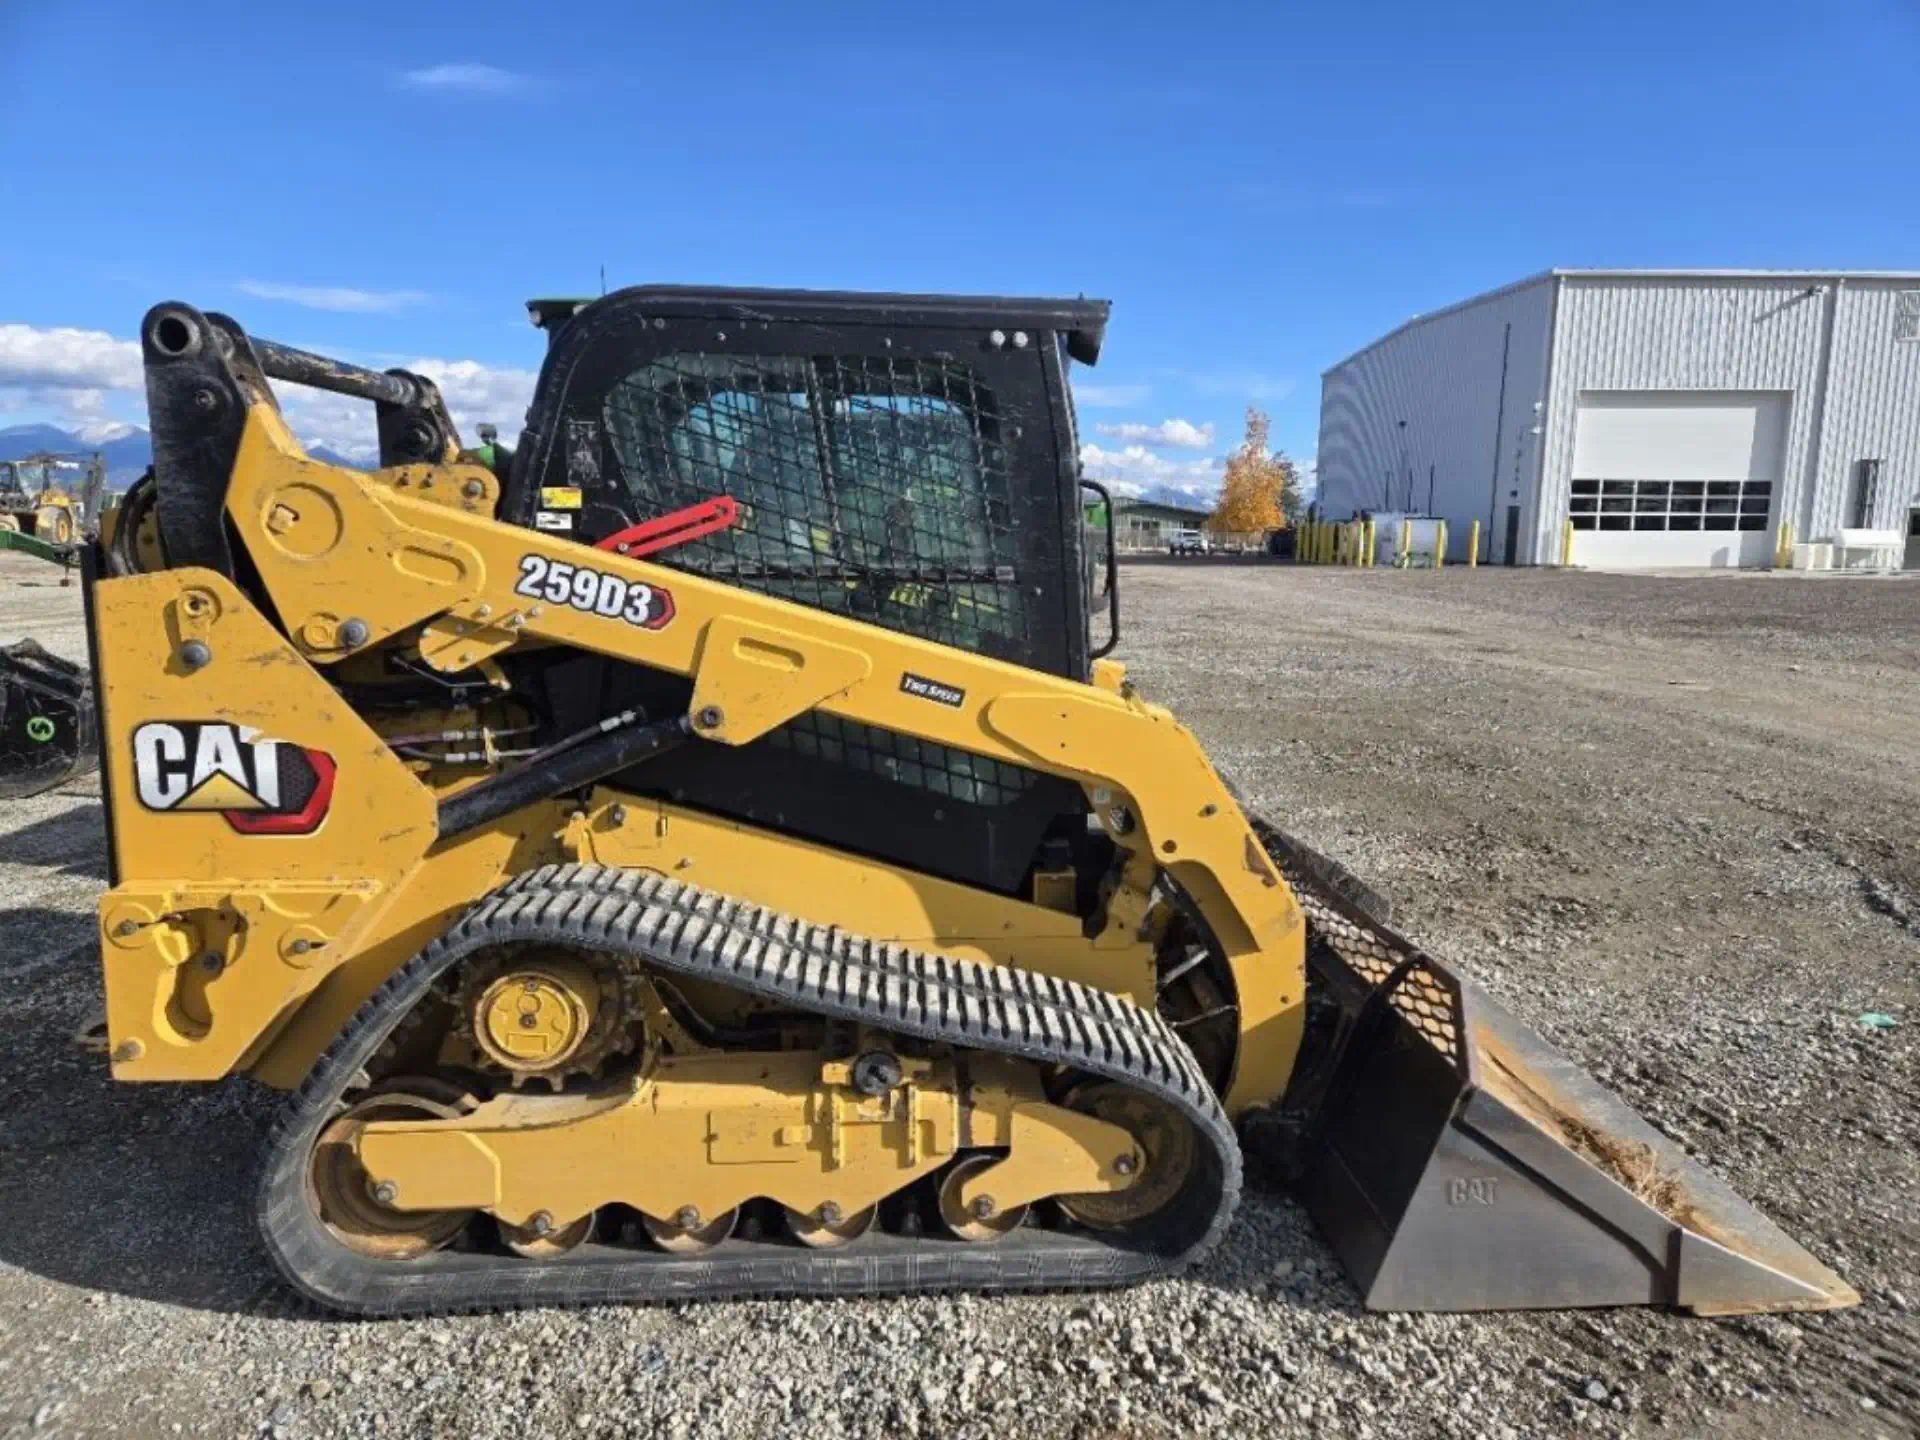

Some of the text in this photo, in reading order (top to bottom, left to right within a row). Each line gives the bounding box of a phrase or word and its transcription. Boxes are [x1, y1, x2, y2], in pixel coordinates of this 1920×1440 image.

[515, 554, 653, 625] 259D3
[133, 722, 281, 809] CAT
[1447, 1175, 1499, 1205] CAT
